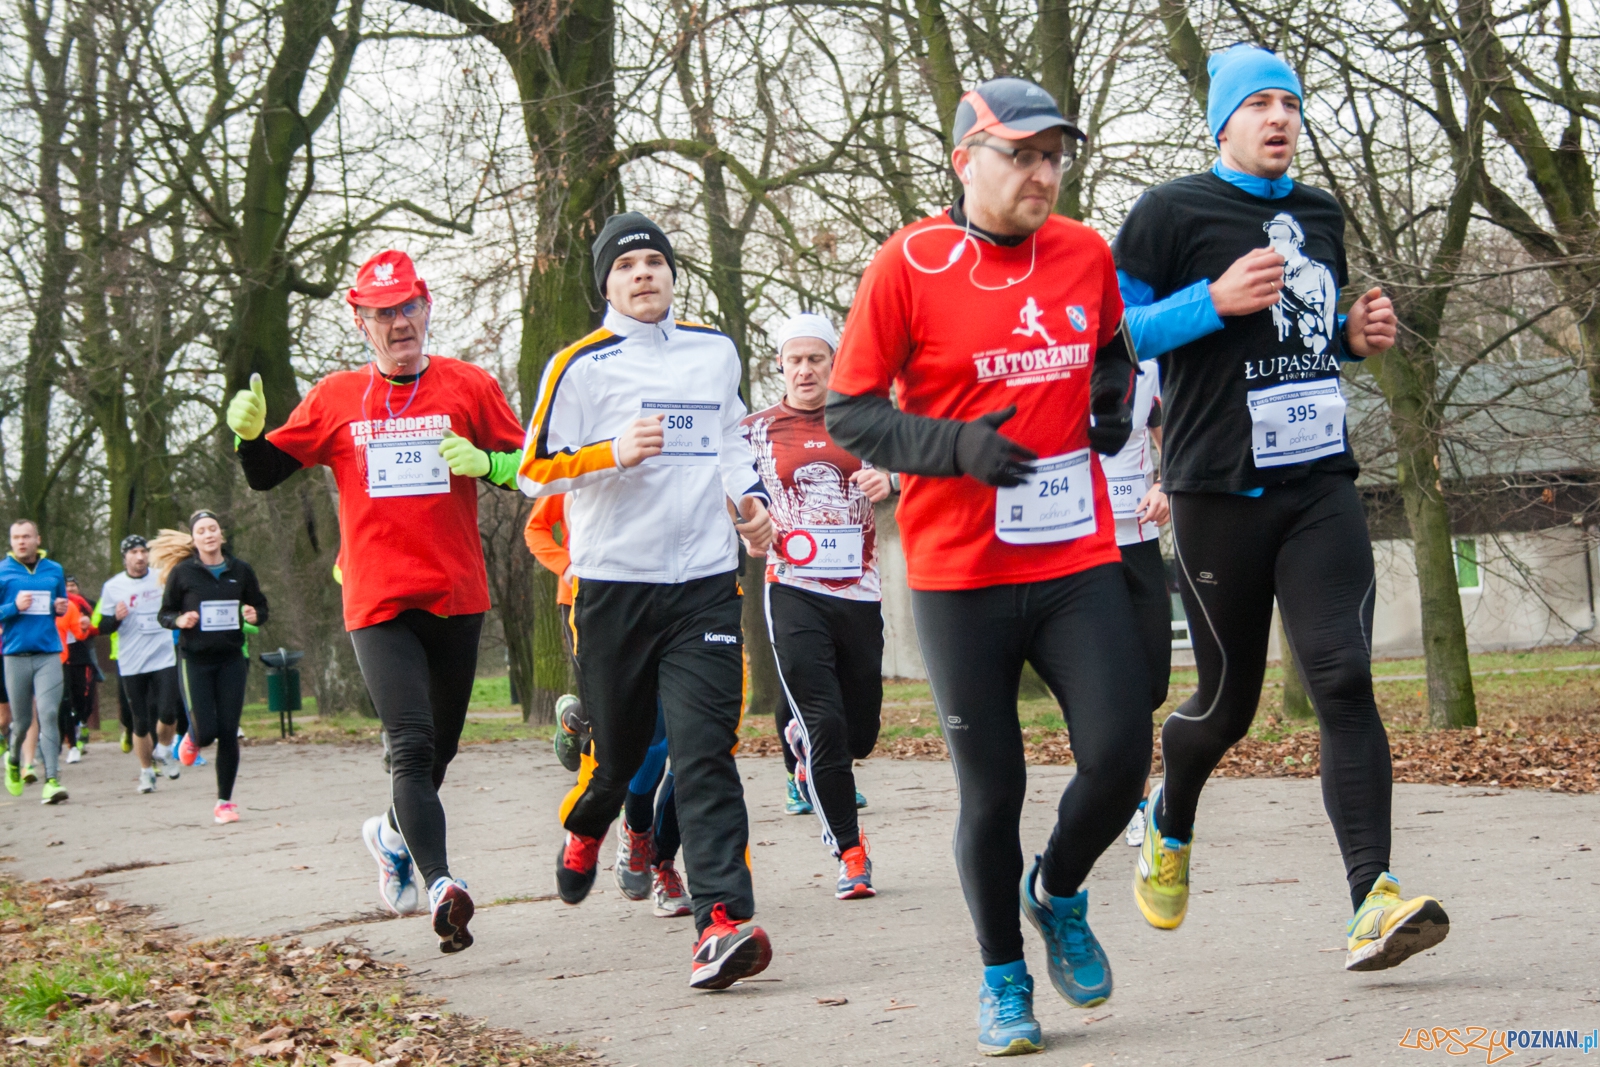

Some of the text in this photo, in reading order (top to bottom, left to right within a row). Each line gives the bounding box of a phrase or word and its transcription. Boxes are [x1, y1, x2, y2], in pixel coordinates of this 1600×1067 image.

[592, 348, 623, 362] Kempa
[1244, 353, 1341, 379] ŁUPASZKA
[1287, 403, 1317, 423] 395
[349, 414, 452, 436] TEST COOPERA
[667, 415, 694, 429] 508
[395, 450, 422, 464] 228
[1039, 476, 1069, 498] 264
[1112, 484, 1132, 496] 399
[820, 538, 837, 549] 44
[704, 631, 737, 644] Kempa
